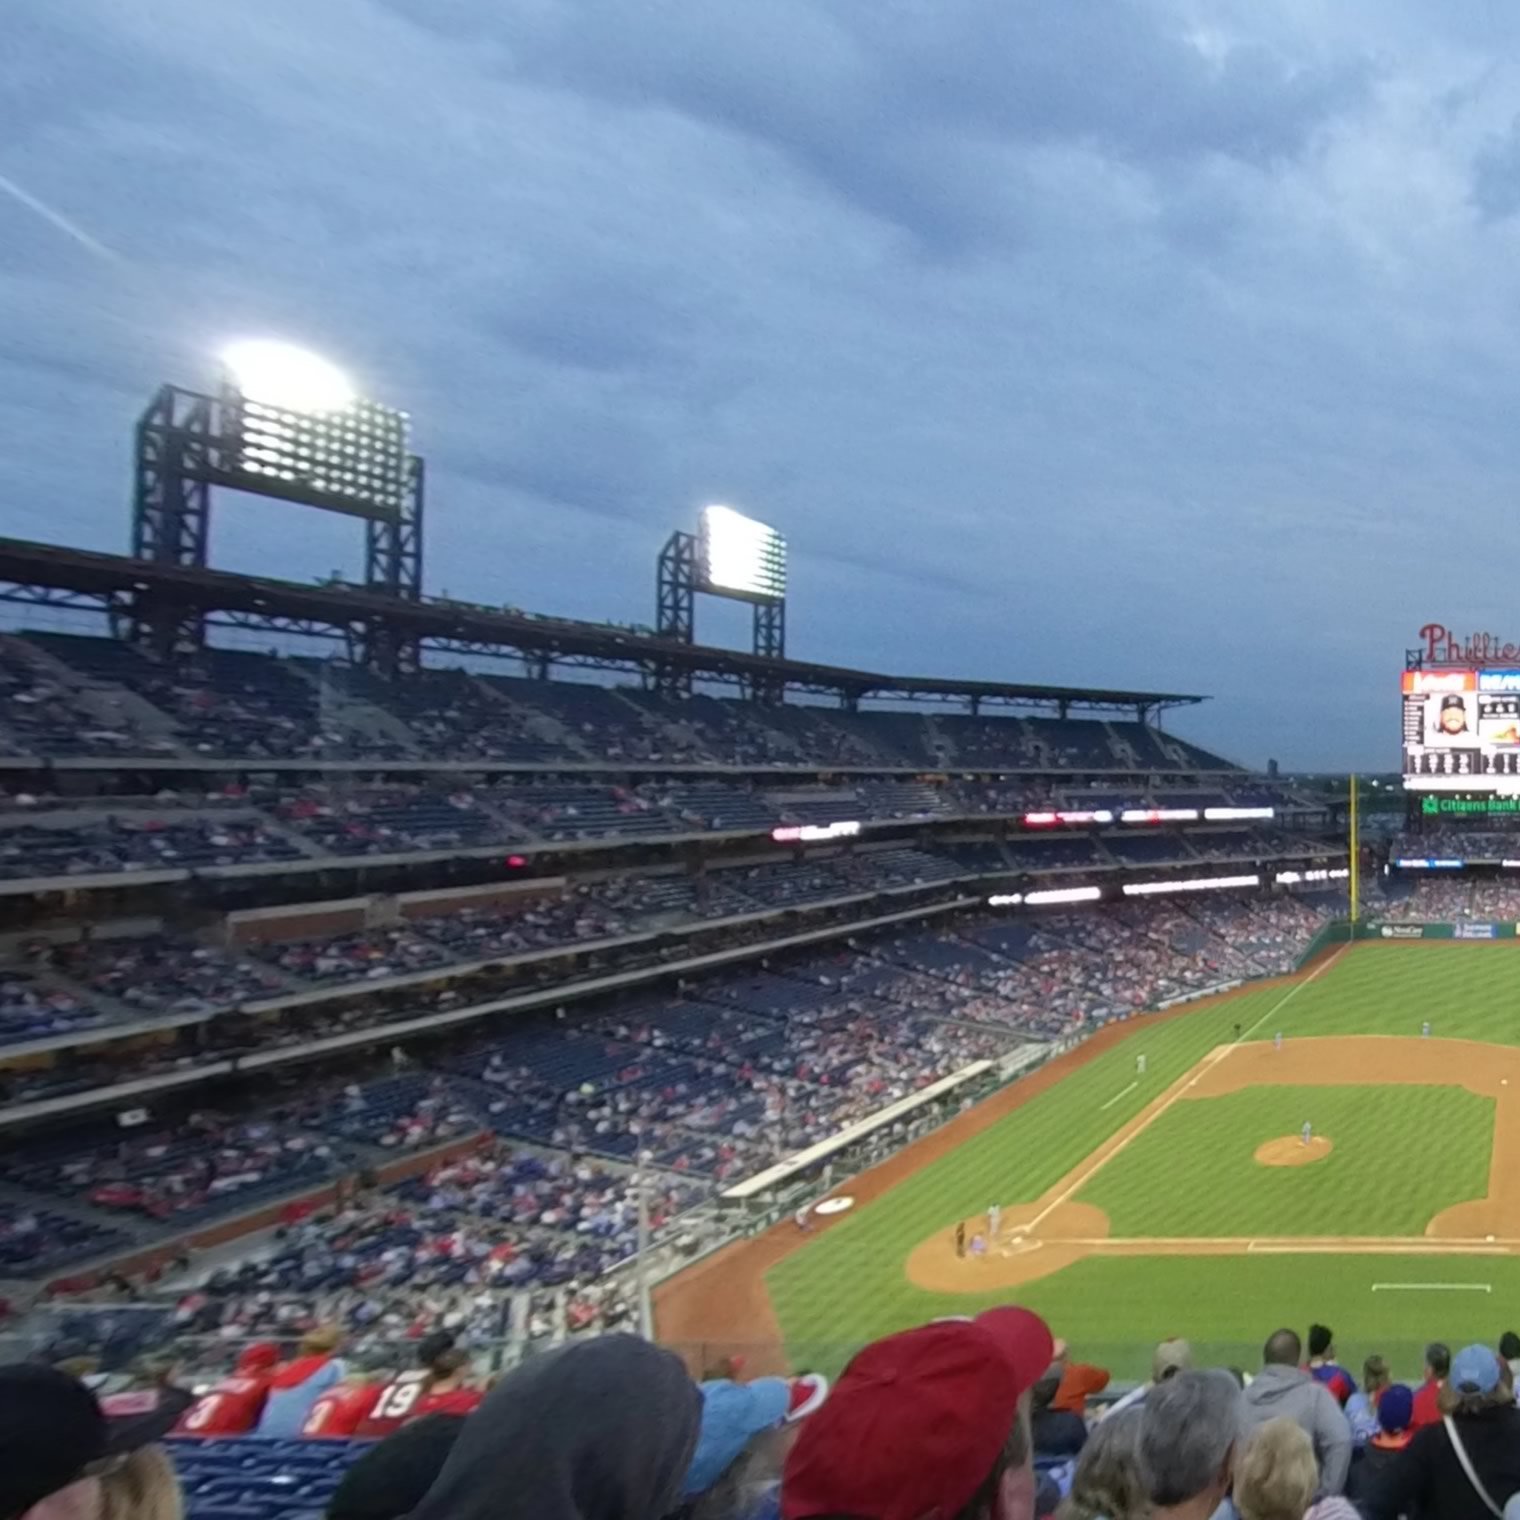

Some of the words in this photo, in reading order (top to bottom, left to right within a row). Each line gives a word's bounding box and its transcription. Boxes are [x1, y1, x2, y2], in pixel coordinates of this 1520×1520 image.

[1440, 799, 1486, 812] Citizens
[1487, 799, 1516, 812] Bank
[369, 1380, 421, 1420] 19
